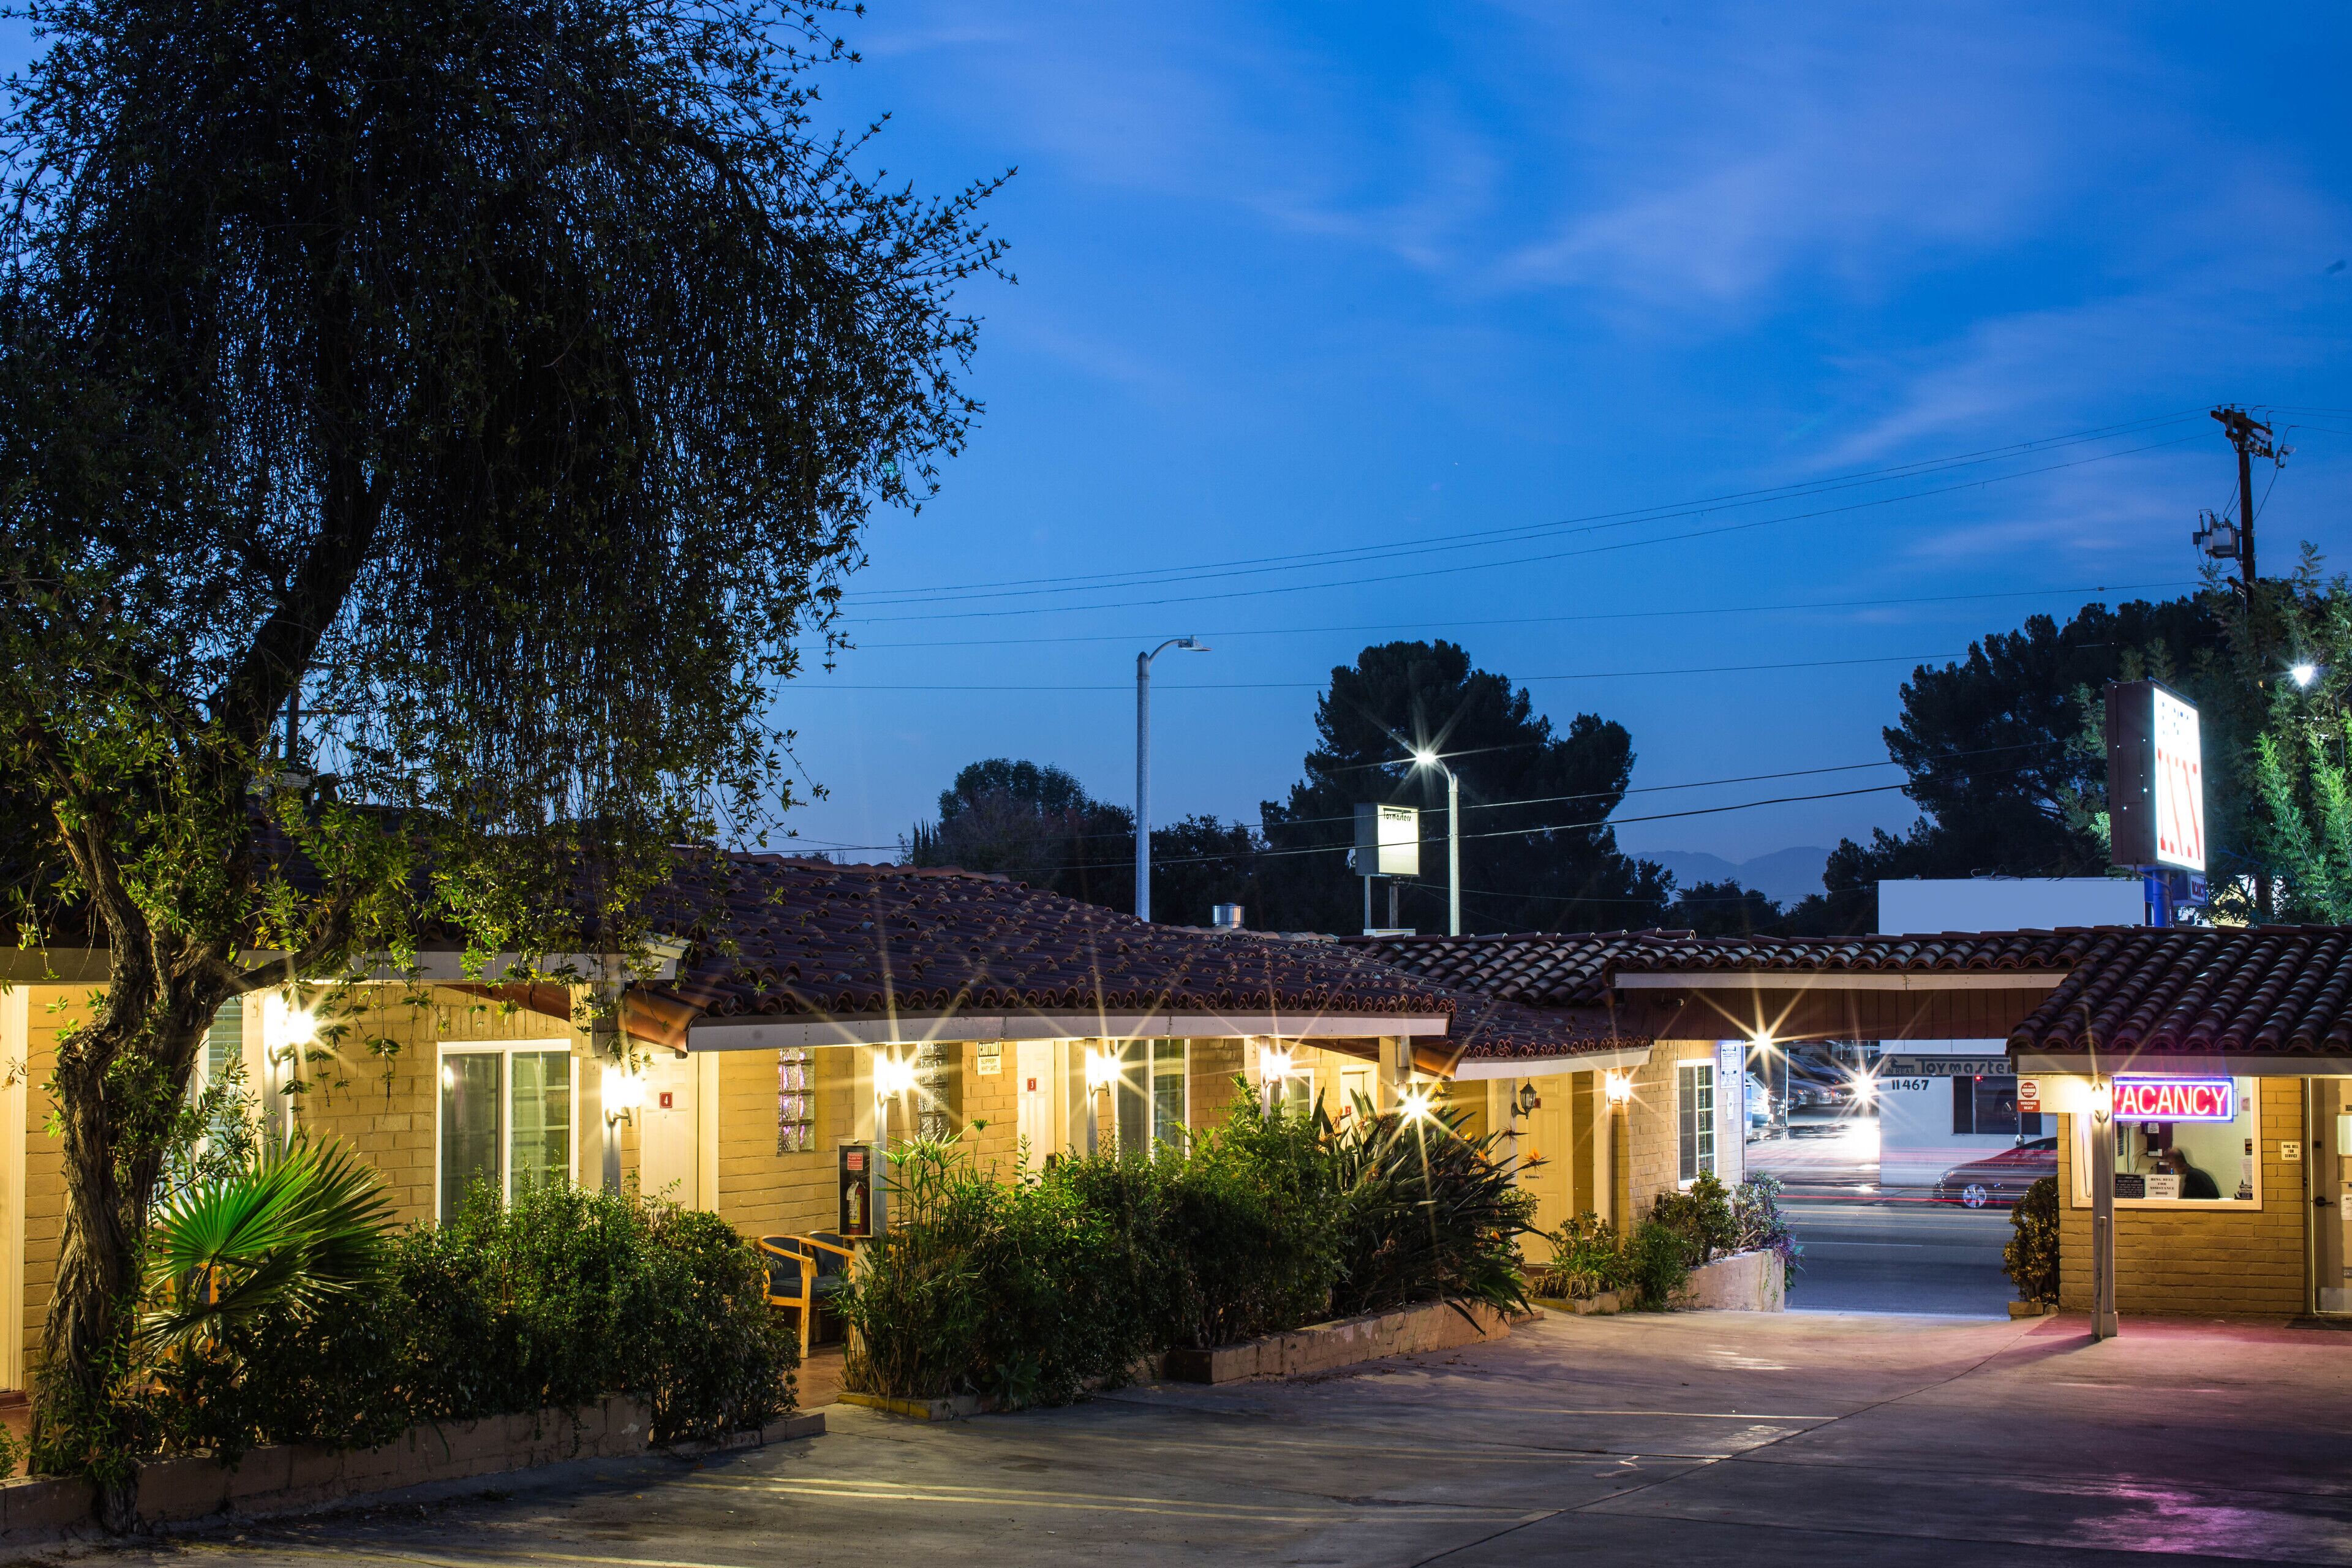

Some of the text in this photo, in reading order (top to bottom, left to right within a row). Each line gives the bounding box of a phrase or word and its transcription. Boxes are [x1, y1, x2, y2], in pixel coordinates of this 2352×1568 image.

[979, 1042, 998, 1056] CAUTION
[1030, 1080, 1034, 1089] 3
[1891, 1079, 1929, 1091] 11467
[664, 1095, 668, 1105] 4
